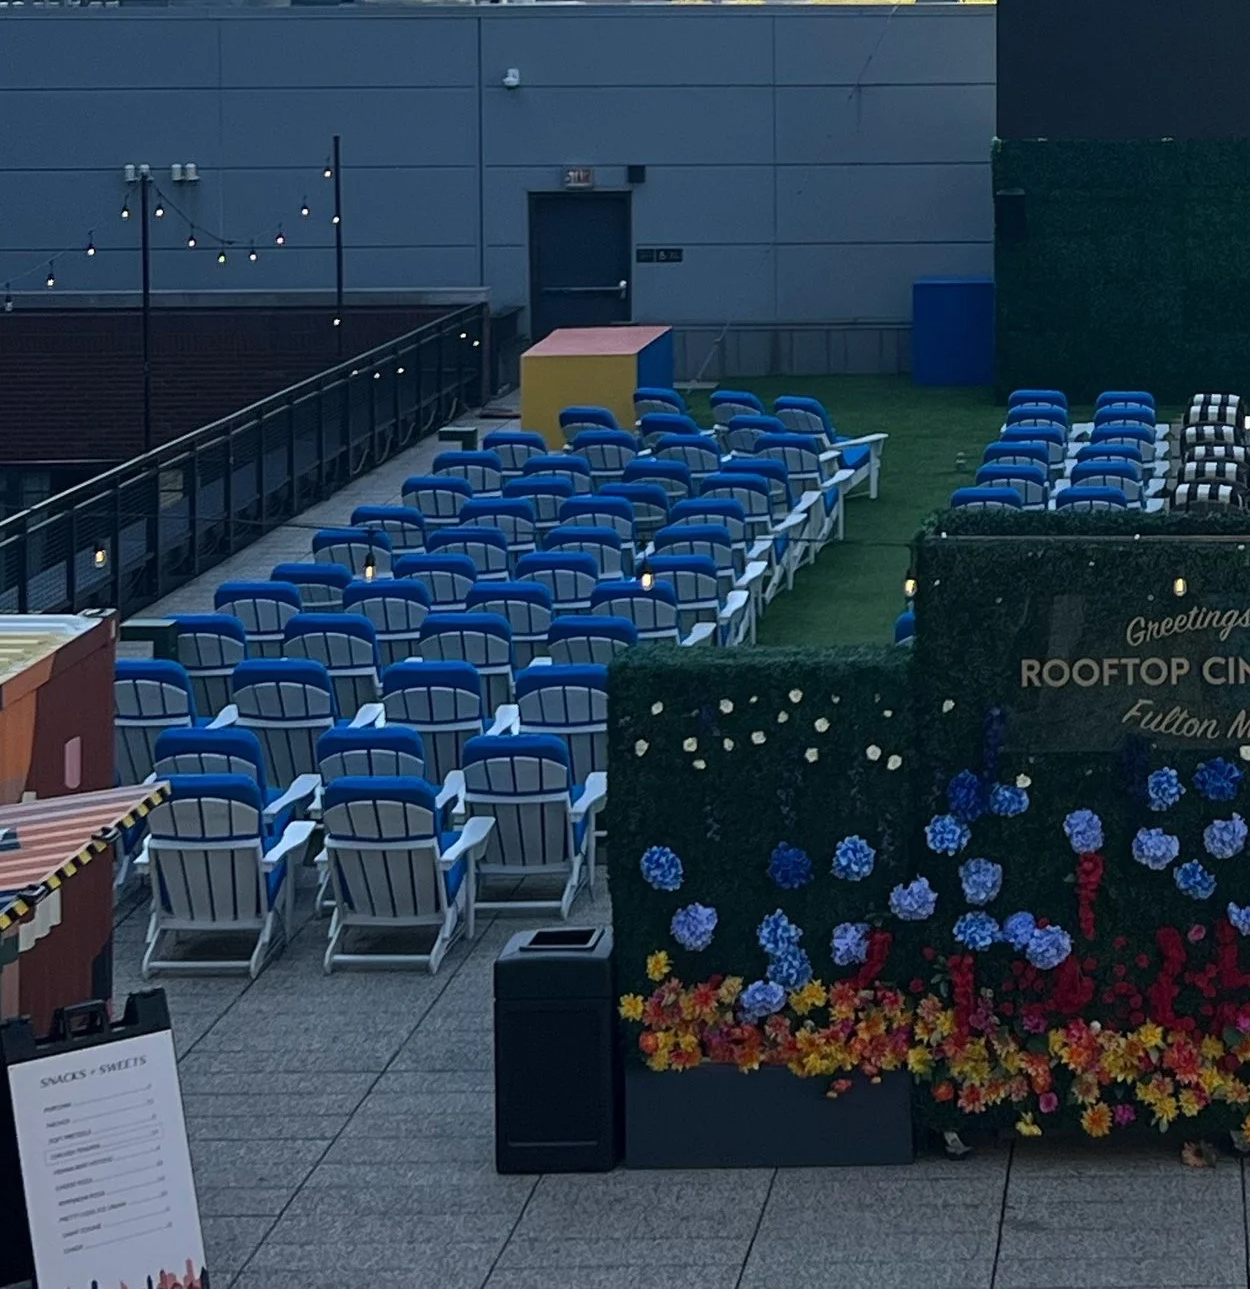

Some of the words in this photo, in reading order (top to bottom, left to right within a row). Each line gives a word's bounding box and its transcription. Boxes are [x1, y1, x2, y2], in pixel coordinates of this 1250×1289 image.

[1020, 657, 1191, 687] ROOFTOP
[1121, 698, 1220, 740] Fulton
[40, 1069, 87, 1089] SNACKS
[99, 1054, 148, 1075] SWEETS
